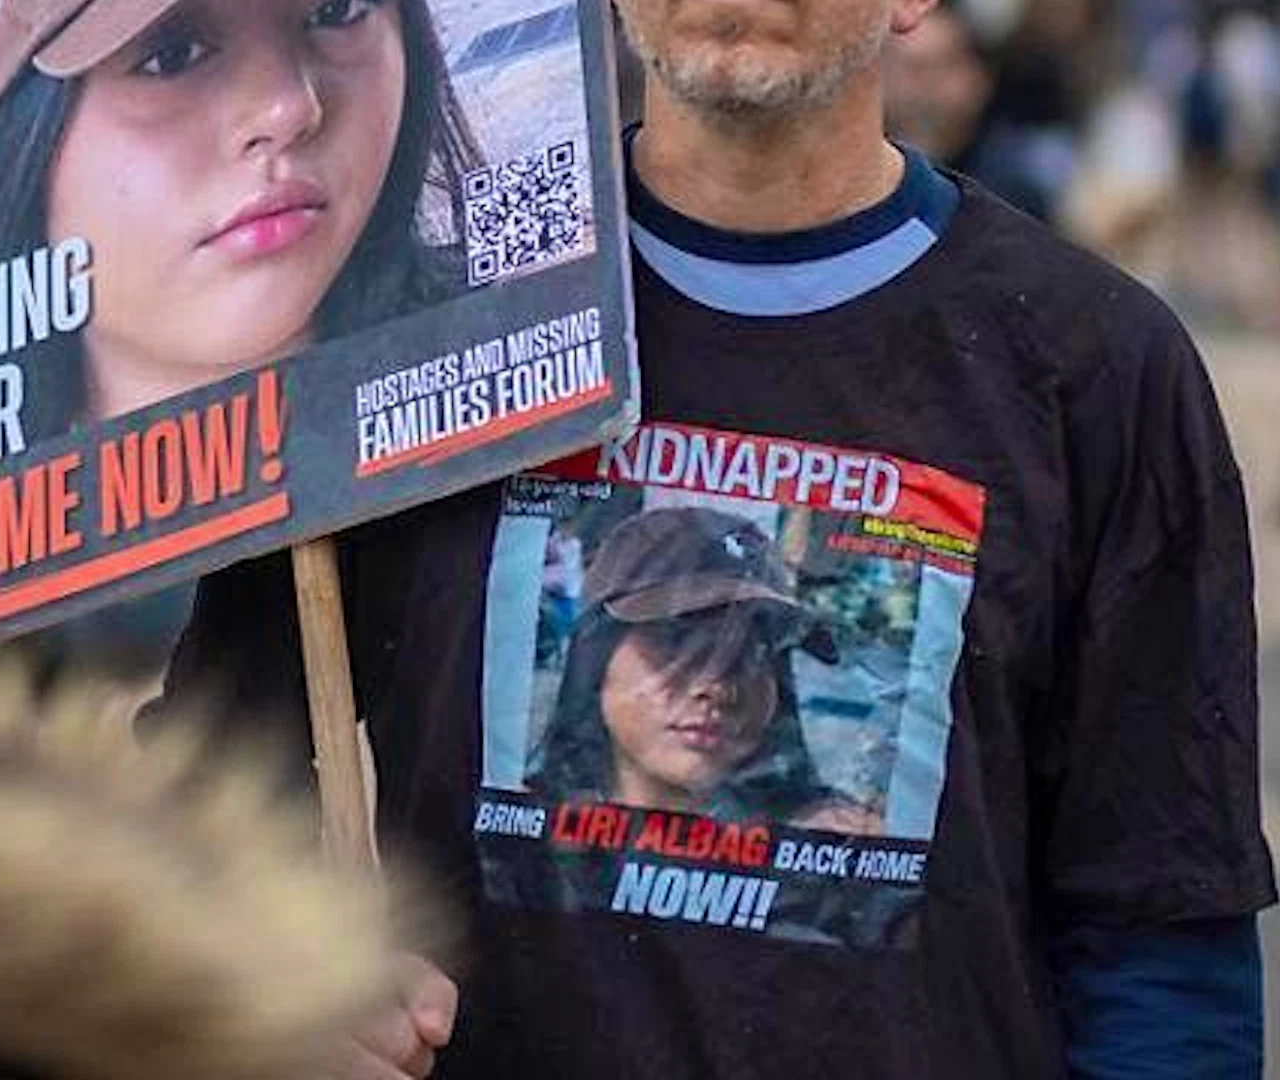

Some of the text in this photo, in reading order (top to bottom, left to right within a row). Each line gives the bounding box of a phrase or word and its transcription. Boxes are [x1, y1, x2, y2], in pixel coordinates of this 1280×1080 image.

[356, 307, 600, 418] HOSTAGES AND MISSING
[358, 341, 605, 463] FAMILIES FORUM
[100, 370, 286, 537] NOW!
[596, 426, 900, 516] KIDNAPPED
[474, 802, 928, 882] BRING LIRI ALBAG BACK HOME
[611, 862, 781, 932] NOW!!
